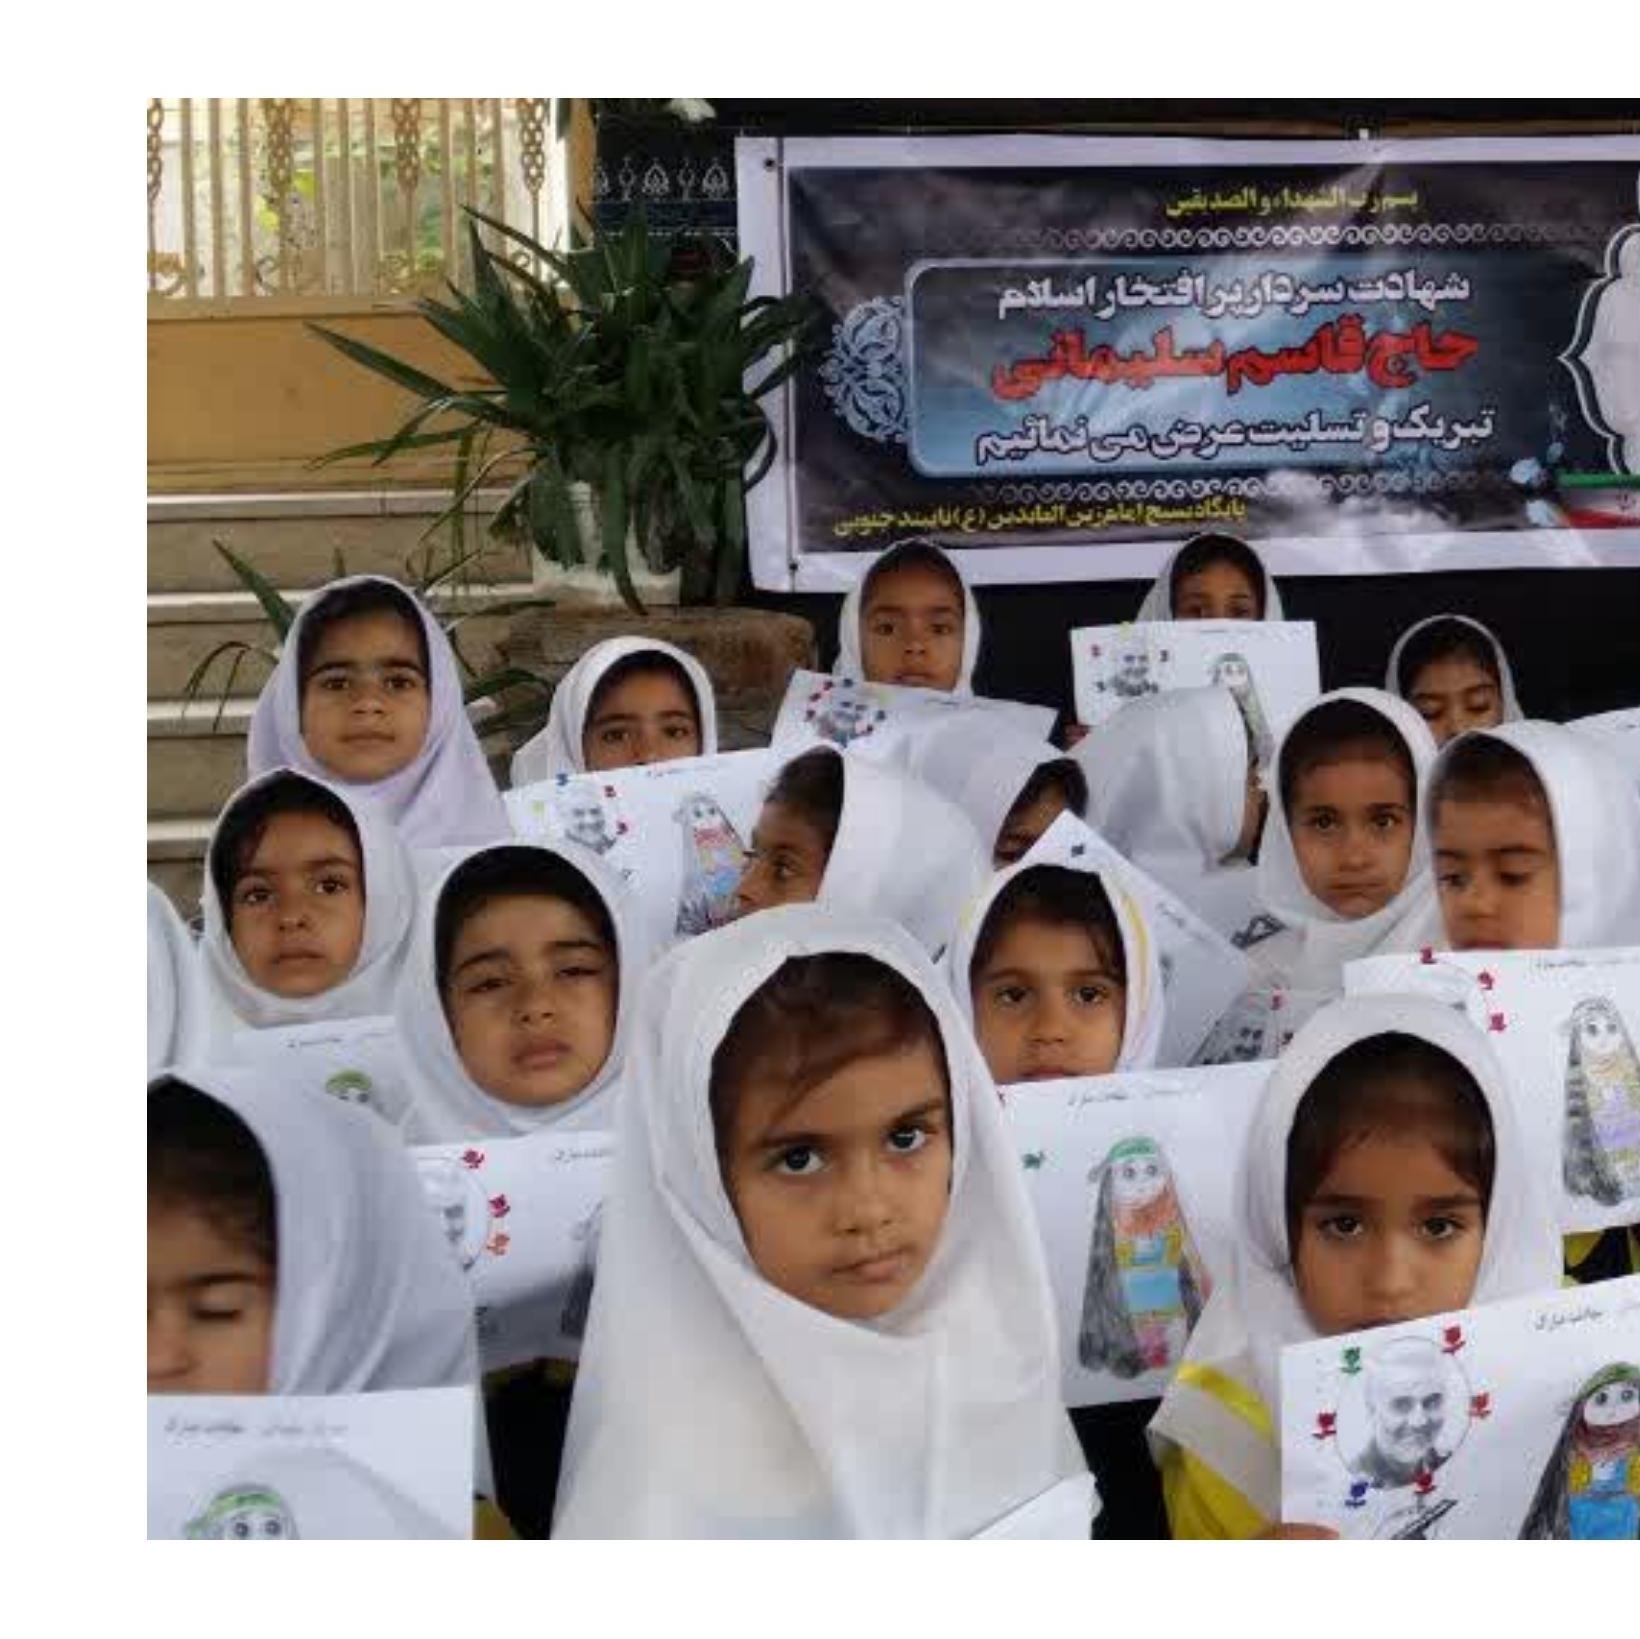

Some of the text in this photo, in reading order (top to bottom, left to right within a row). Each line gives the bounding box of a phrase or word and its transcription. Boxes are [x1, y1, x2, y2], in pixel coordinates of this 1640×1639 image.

[998, 275, 1096, 318] اسلام
[1096, 269, 1205, 320] افتخار
[1242, 271, 1344, 316] سردار
[1347, 270, 1470, 313] شهادت
[990, 313, 1480, 400] حاج قاسم سلیمانی
[1089, 425, 1152, 463] می
[1152, 417, 1250, 461] عرض
[1251, 410, 1366, 450] تسلیت
[1367, 422, 1391, 454] و
[1388, 404, 1496, 451] تبریک
